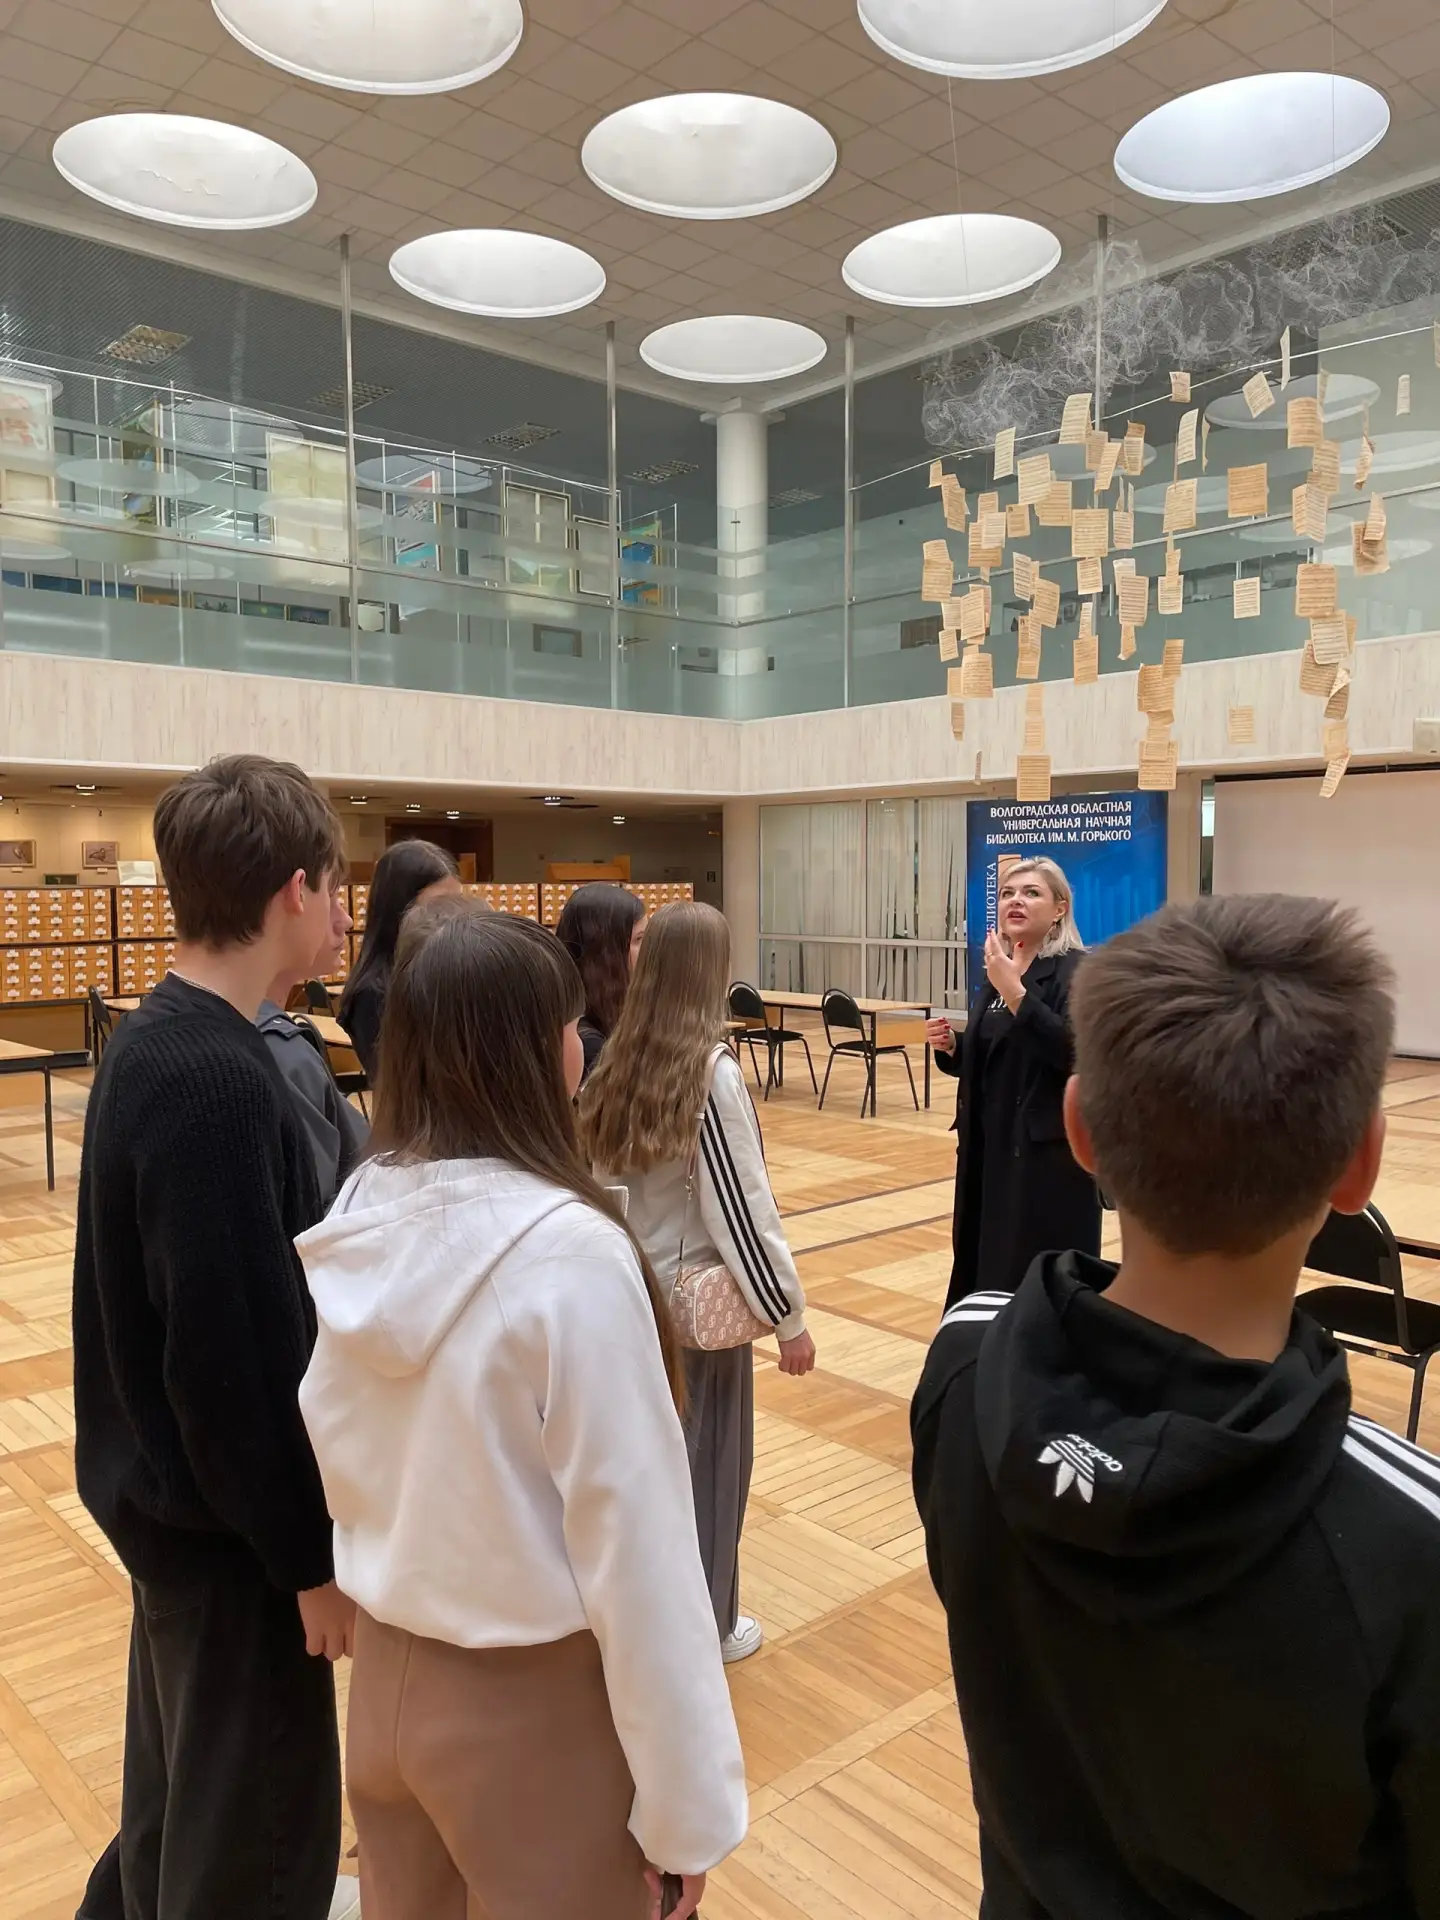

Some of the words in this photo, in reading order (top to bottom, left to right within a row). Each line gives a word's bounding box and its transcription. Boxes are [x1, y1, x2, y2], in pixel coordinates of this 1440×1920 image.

[990, 805, 1068, 818] ВОЛГОГРАДСКАЯ
[1071, 801, 1132, 815] ОБЛАСТНАЯ
[1003, 818, 1080, 831] УНИВЕРСАЛЬНАЯ
[1085, 815, 1132, 828] НАУЧНАЯ
[986, 832, 1046, 845] БИБЛИОТЕКА
[1048, 831, 1066, 843] ИМ.
[1067, 831, 1080, 843] М.
[1081, 829, 1132, 842] ГОРЬКОГО
[986, 862, 997, 935] БЛИОТЕКА
[1066, 1434, 1123, 1472] adidas
